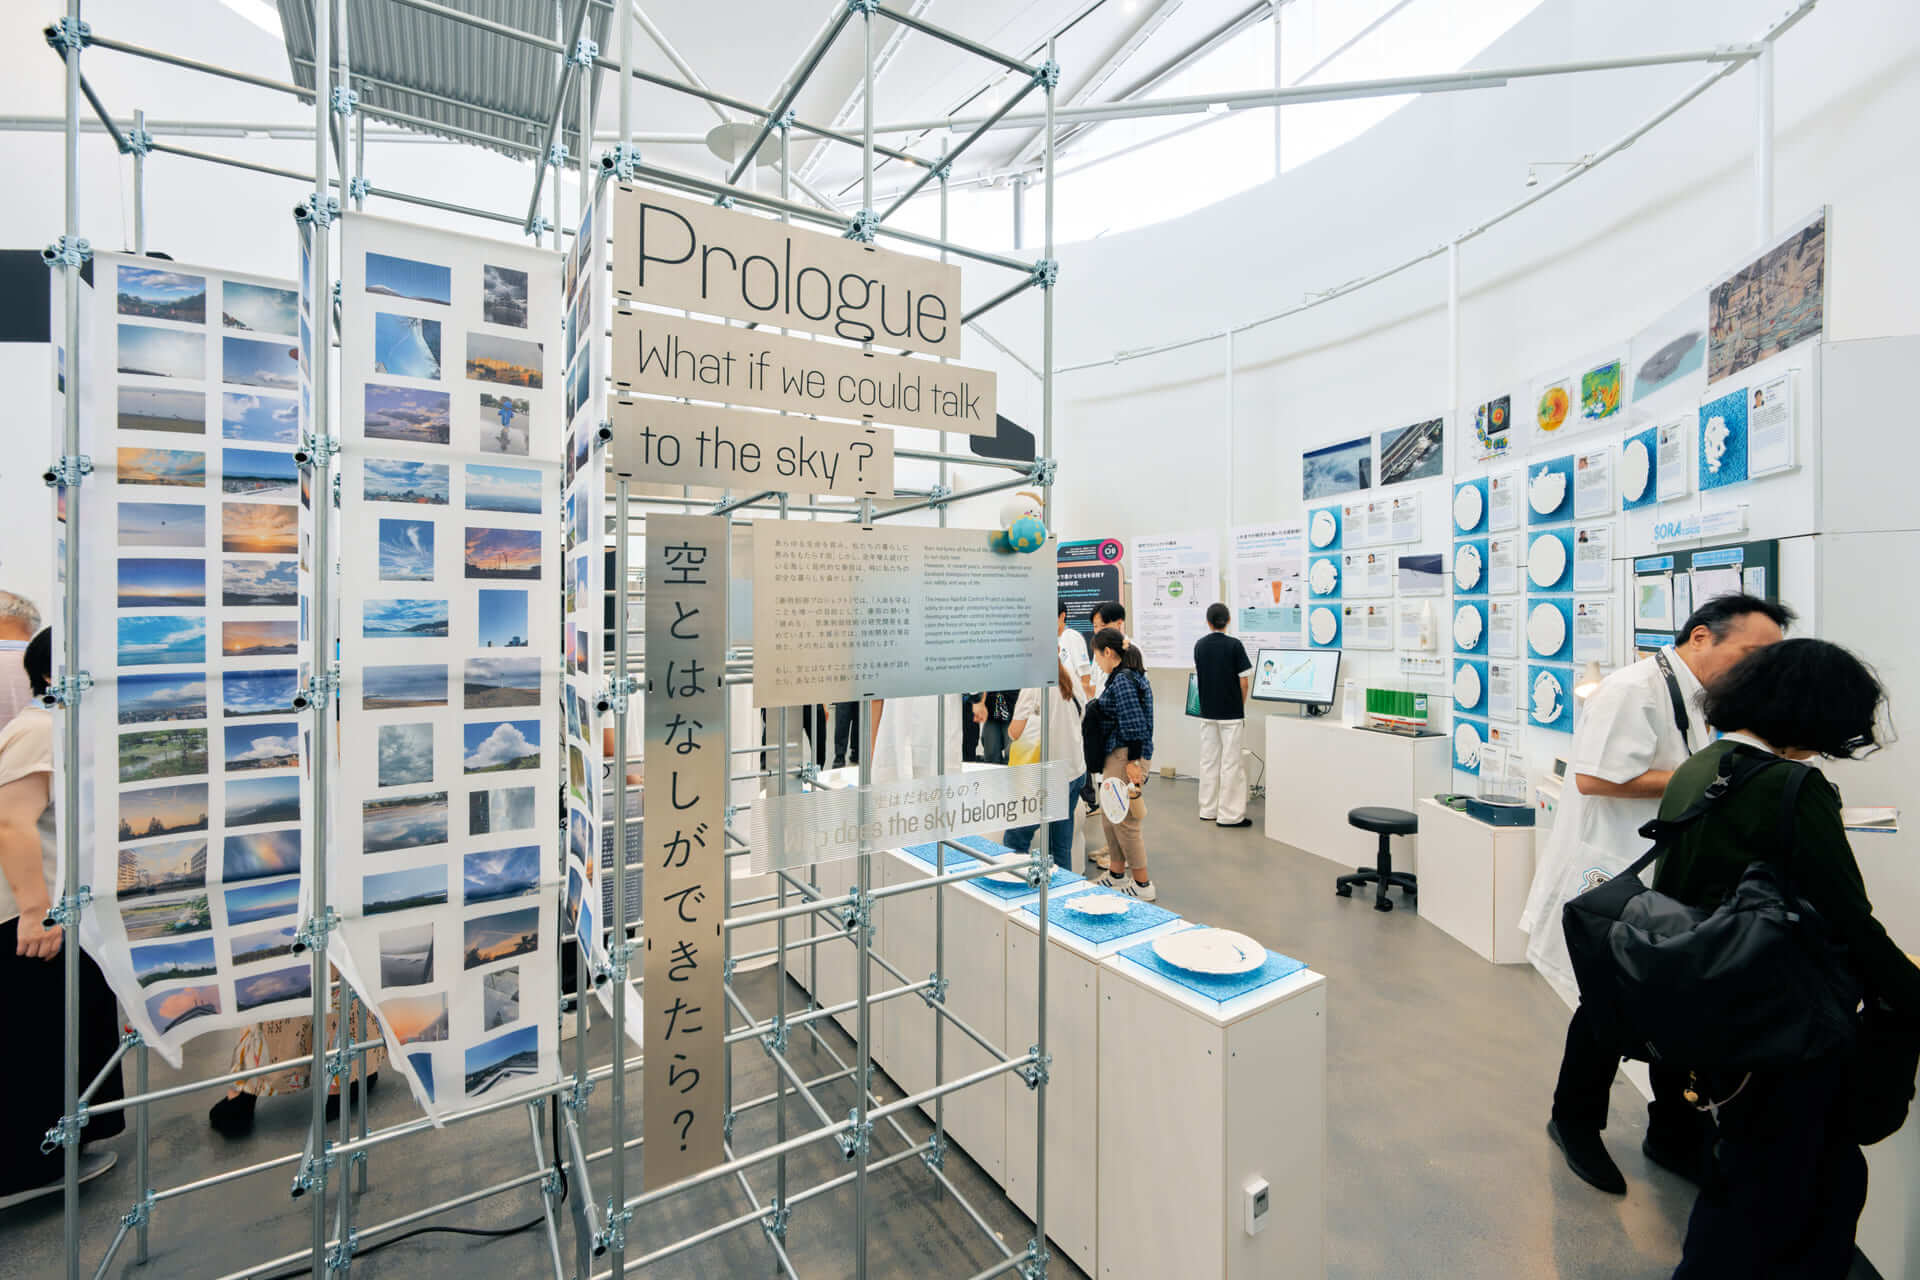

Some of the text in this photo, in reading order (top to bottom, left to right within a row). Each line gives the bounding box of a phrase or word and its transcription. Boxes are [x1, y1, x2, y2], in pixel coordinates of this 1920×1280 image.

[638, 202, 948, 343] Prologue
[637, 328, 981, 421] What if we could talk
[639, 424, 874, 490] to the sky ?
[662, 540, 709, 1152] 空とはなしができたら？
[888, 810, 920, 836] the
[924, 806, 957, 832] sky
[961, 799, 1018, 823] belong
